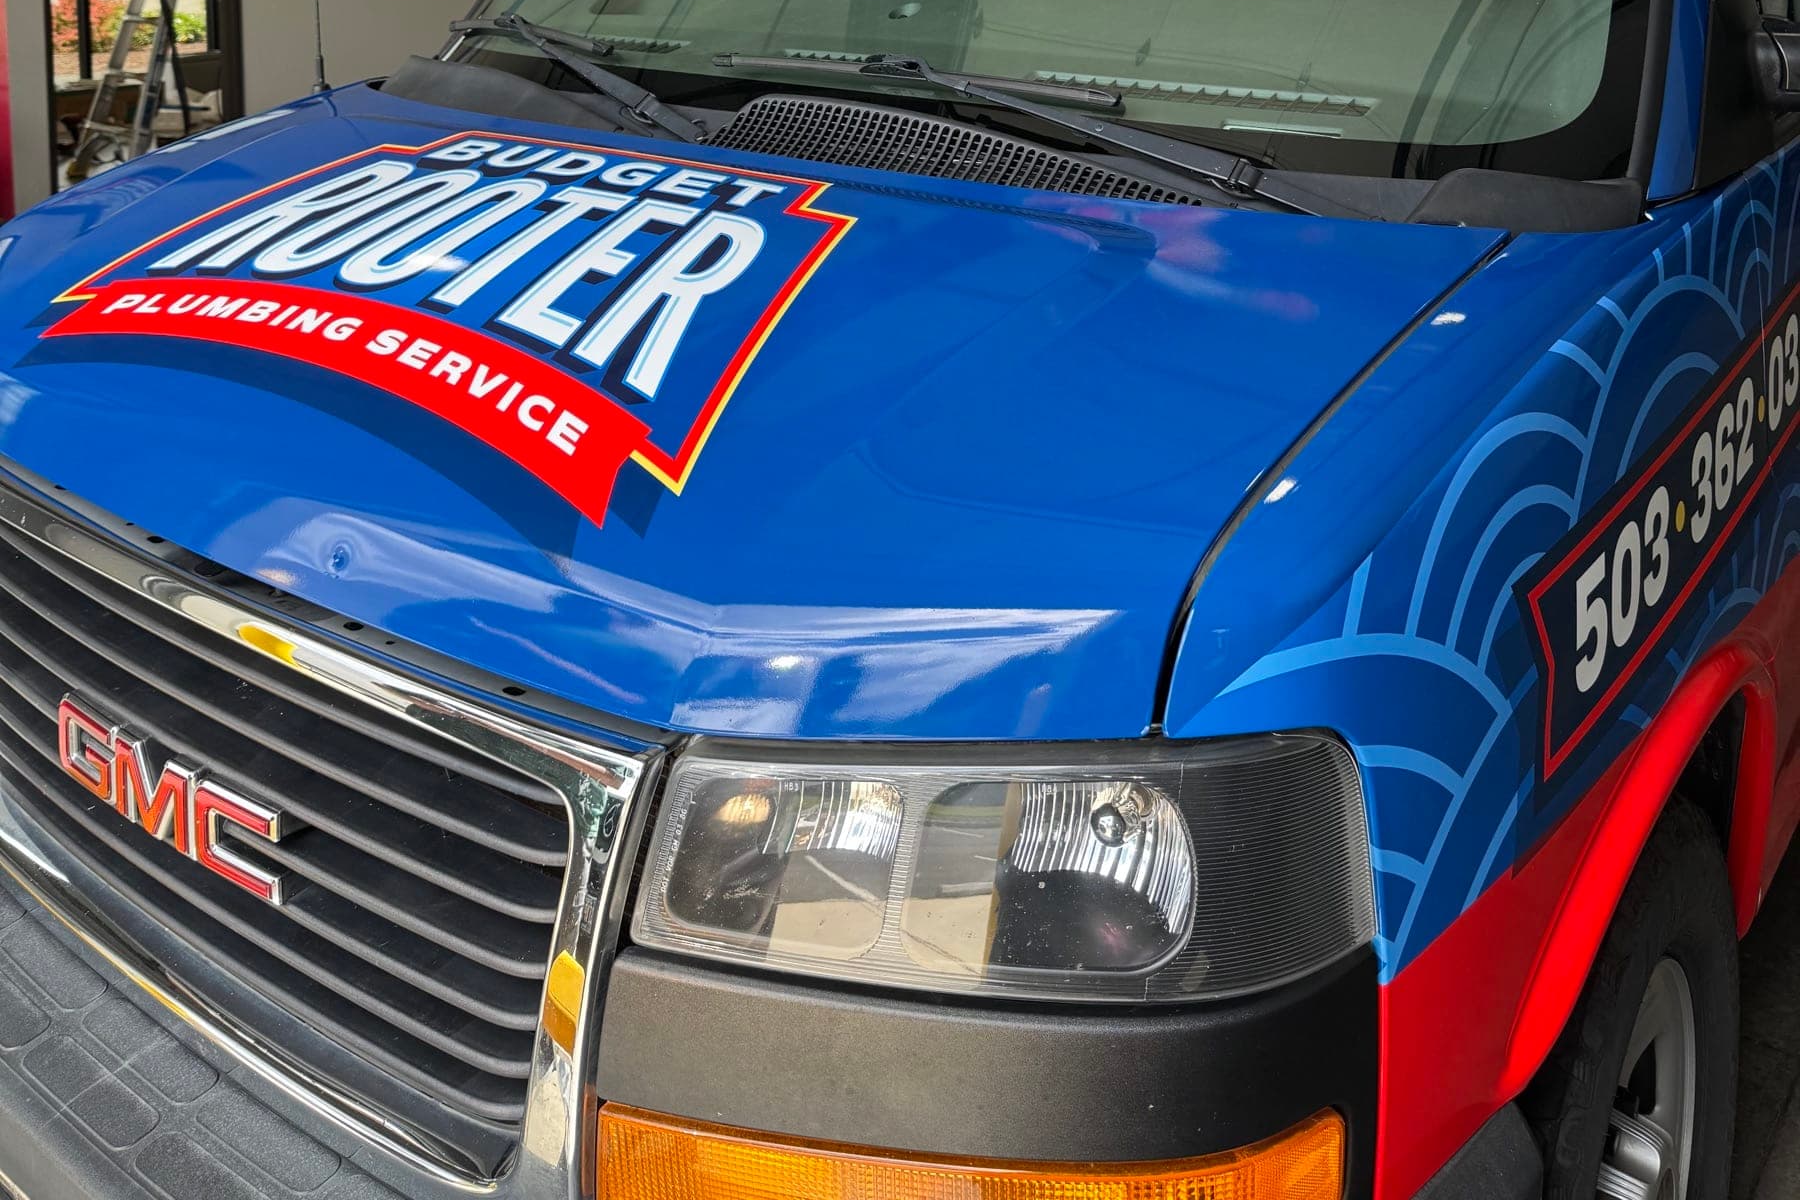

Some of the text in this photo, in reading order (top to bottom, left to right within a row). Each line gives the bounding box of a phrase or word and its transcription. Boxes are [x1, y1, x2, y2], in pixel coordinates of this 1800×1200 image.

[425, 138, 788, 207] BUDGET
[145, 159, 768, 402] ROOTER
[100, 293, 590, 457] PLUMBING SERVICE
[57, 693, 283, 906] GMC
